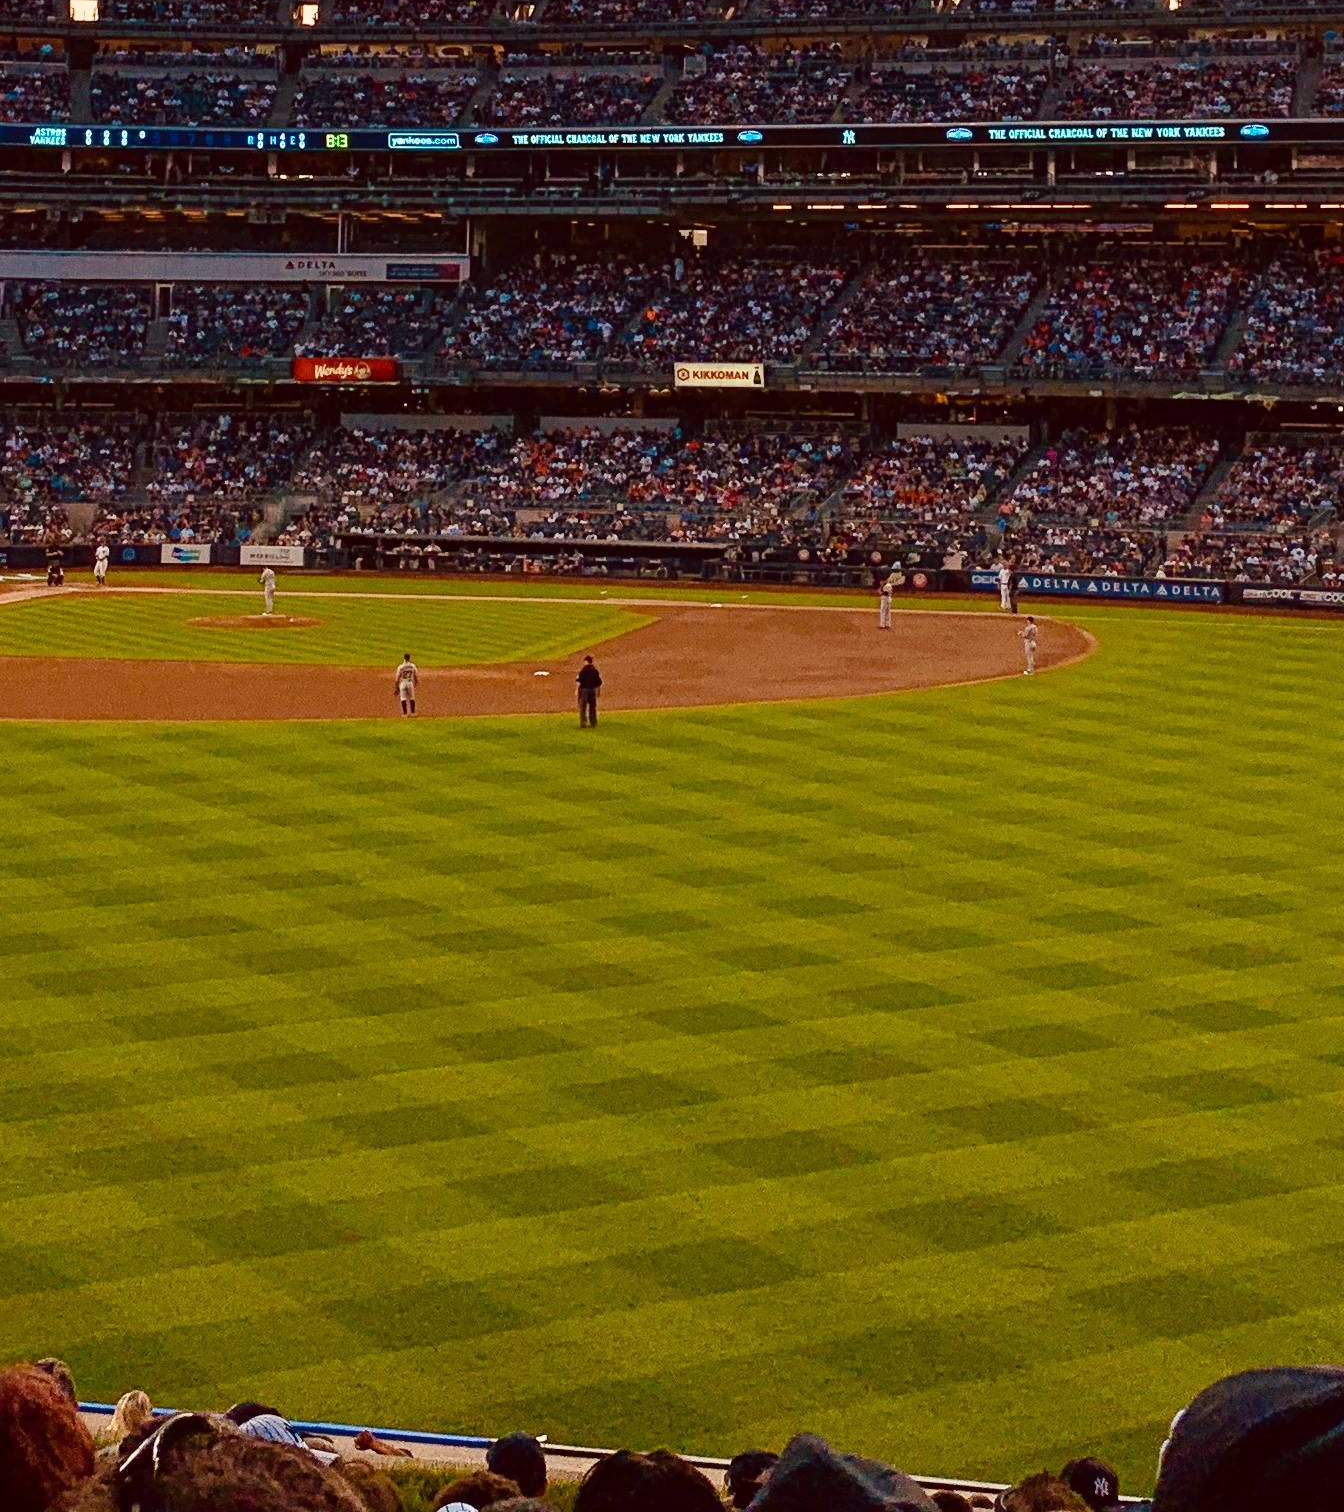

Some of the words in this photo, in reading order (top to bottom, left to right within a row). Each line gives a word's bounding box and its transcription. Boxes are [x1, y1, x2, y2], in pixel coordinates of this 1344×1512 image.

[34, 128, 67, 137] ASTROS
[84, 128, 93, 137] 0
[102, 129, 111, 138] 0
[120, 129, 129, 138] 0
[138, 130, 147, 139] 0
[512, 135, 528, 144] THE
[531, 135, 564, 144] OFFICIAL
[566, 134, 606, 143] CHARCOAL
[609, 134, 619, 143] OF
[621, 134, 637, 143] THE
[640, 134, 660, 143] NEW
[663, 133, 684, 142] YORK
[688, 133, 723, 142] YANKEES
[989, 130, 1006, 139] THE
[1009, 129, 1046, 139] OFFICIAL
[1049, 129, 1093, 138] CHARCOAL
[1096, 128, 1107, 138] OF
[1110, 128, 1128, 138] THE
[1132, 128, 1153, 137] NEW
[1157, 128, 1180, 137] YORK
[1184, 127, 1225, 137] YANKEES
[29, 136, 66, 145] YANKEES
[84, 137, 93, 146] 0
[102, 137, 111, 146] 0
[120, 137, 129, 146] 0
[325, 133, 349, 149] 8:13
[391, 136, 456, 146] yankees.com
[298, 261, 336, 269] DELTA
[314, 362, 353, 379] Wendy's
[692, 370, 749, 380] KIKKOMAN
[1032, 578, 1080, 590] DELTA
[1101, 581, 1149, 593] DELTA
[1172, 585, 1220, 597] DELTA
[1265, 589, 1294, 599] COOL
